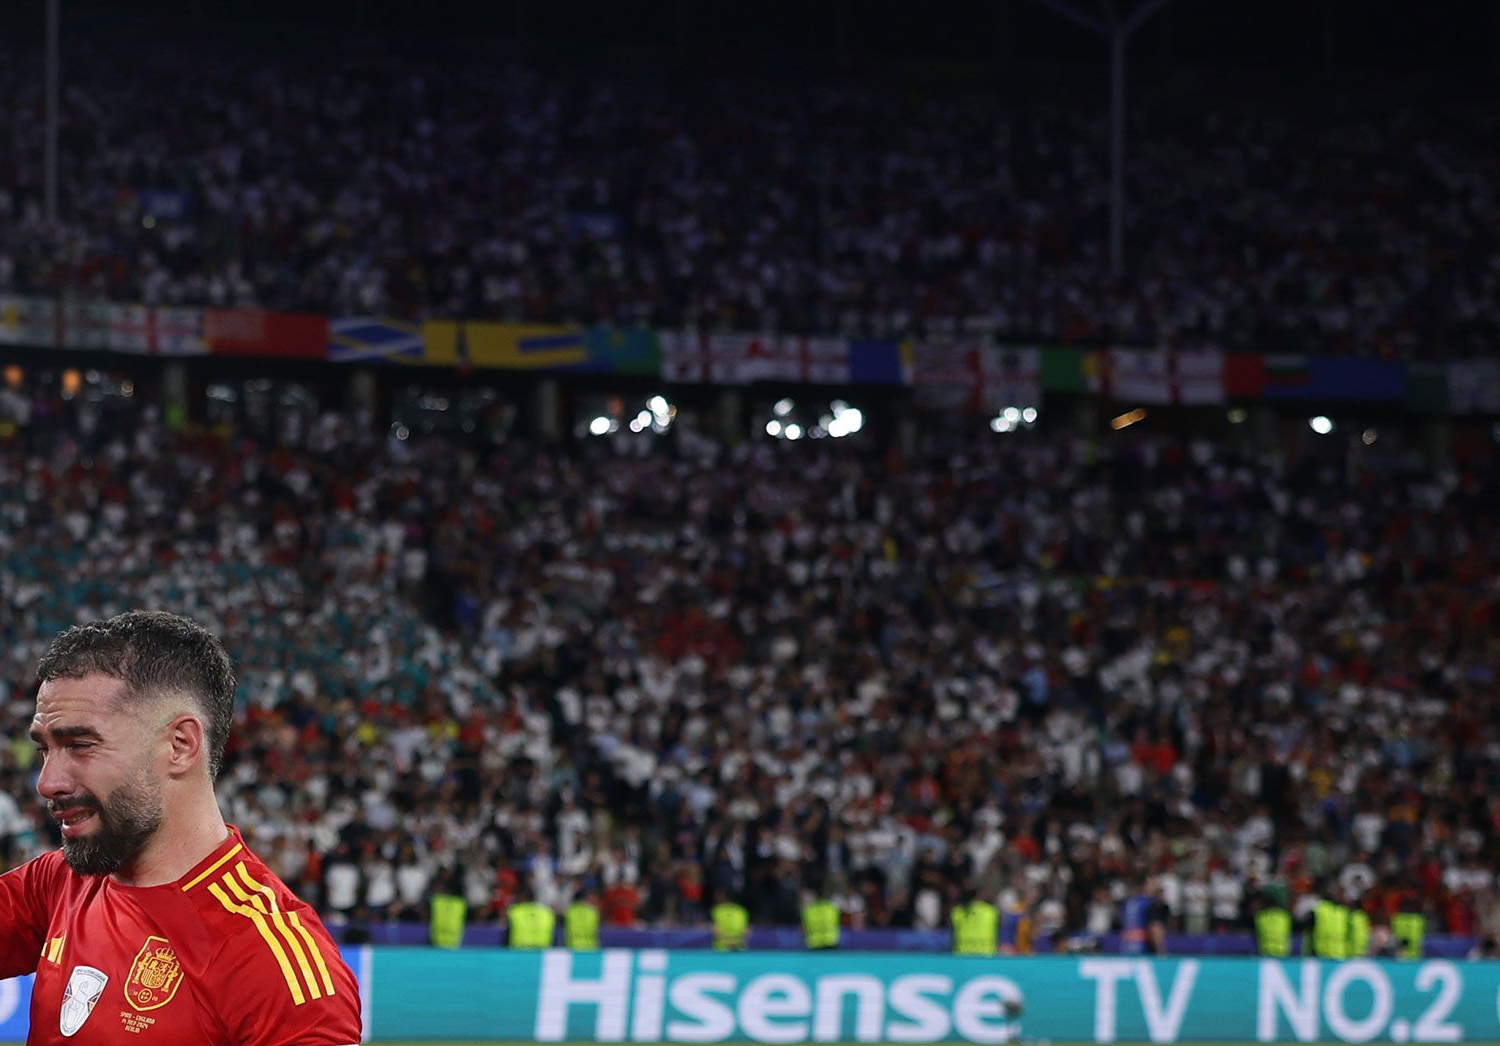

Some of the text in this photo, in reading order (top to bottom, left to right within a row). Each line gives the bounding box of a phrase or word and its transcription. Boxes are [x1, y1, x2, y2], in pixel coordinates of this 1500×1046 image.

[534, 948, 1024, 1044] Hisense
[1079, 957, 1463, 1044] TV NO.2
